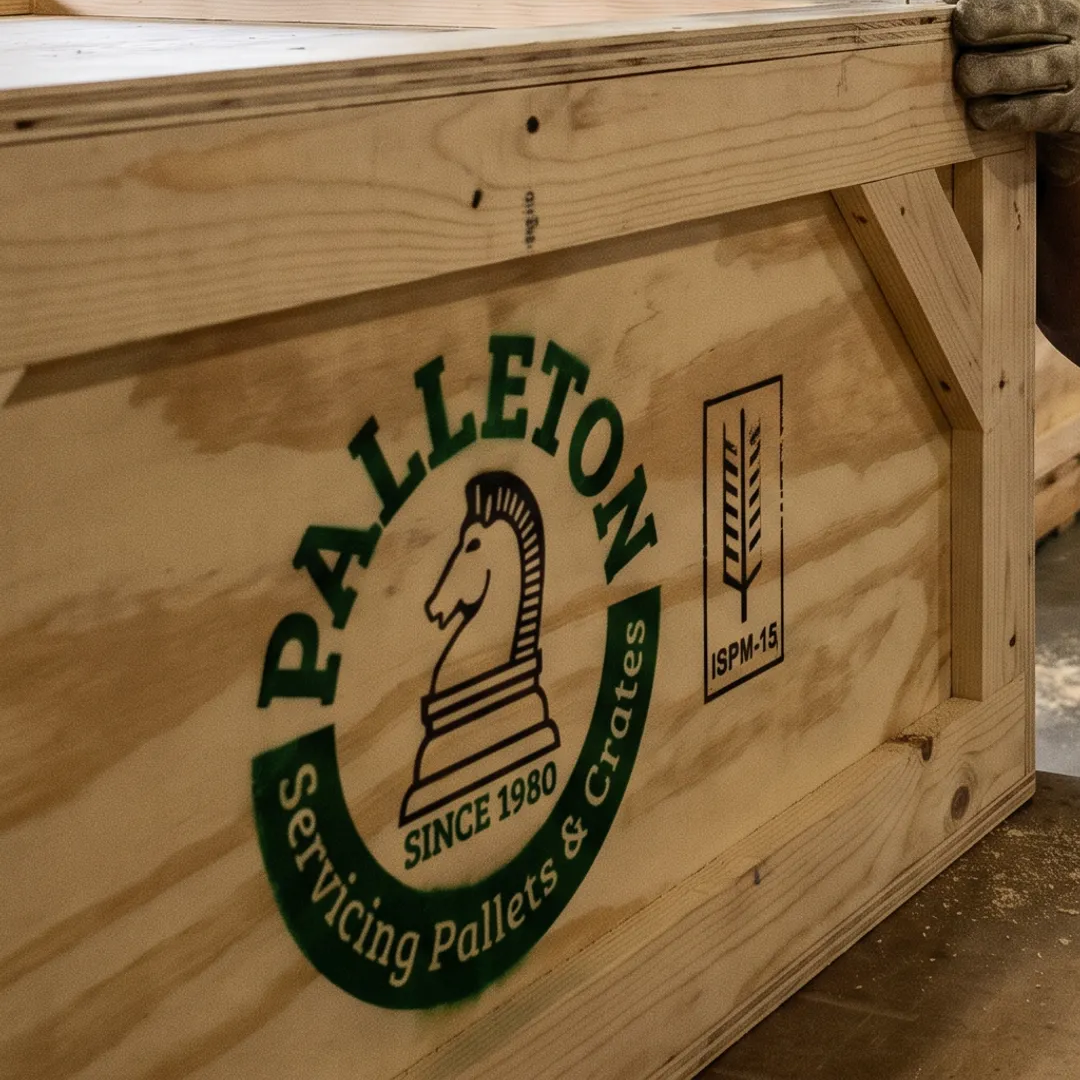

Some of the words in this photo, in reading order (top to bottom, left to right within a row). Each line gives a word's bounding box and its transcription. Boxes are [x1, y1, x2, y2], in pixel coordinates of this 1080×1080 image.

[257, 334, 659, 710] PALLETON
[711, 621, 778, 680] ISPM-15
[279, 763, 420, 988] Servicing
[427, 858, 559, 972] Pallets
[561, 814, 589, 860] &
[584, 619, 646, 807] Crates
[404, 792, 491, 870] SINCE
[497, 760, 558, 822] 1980
